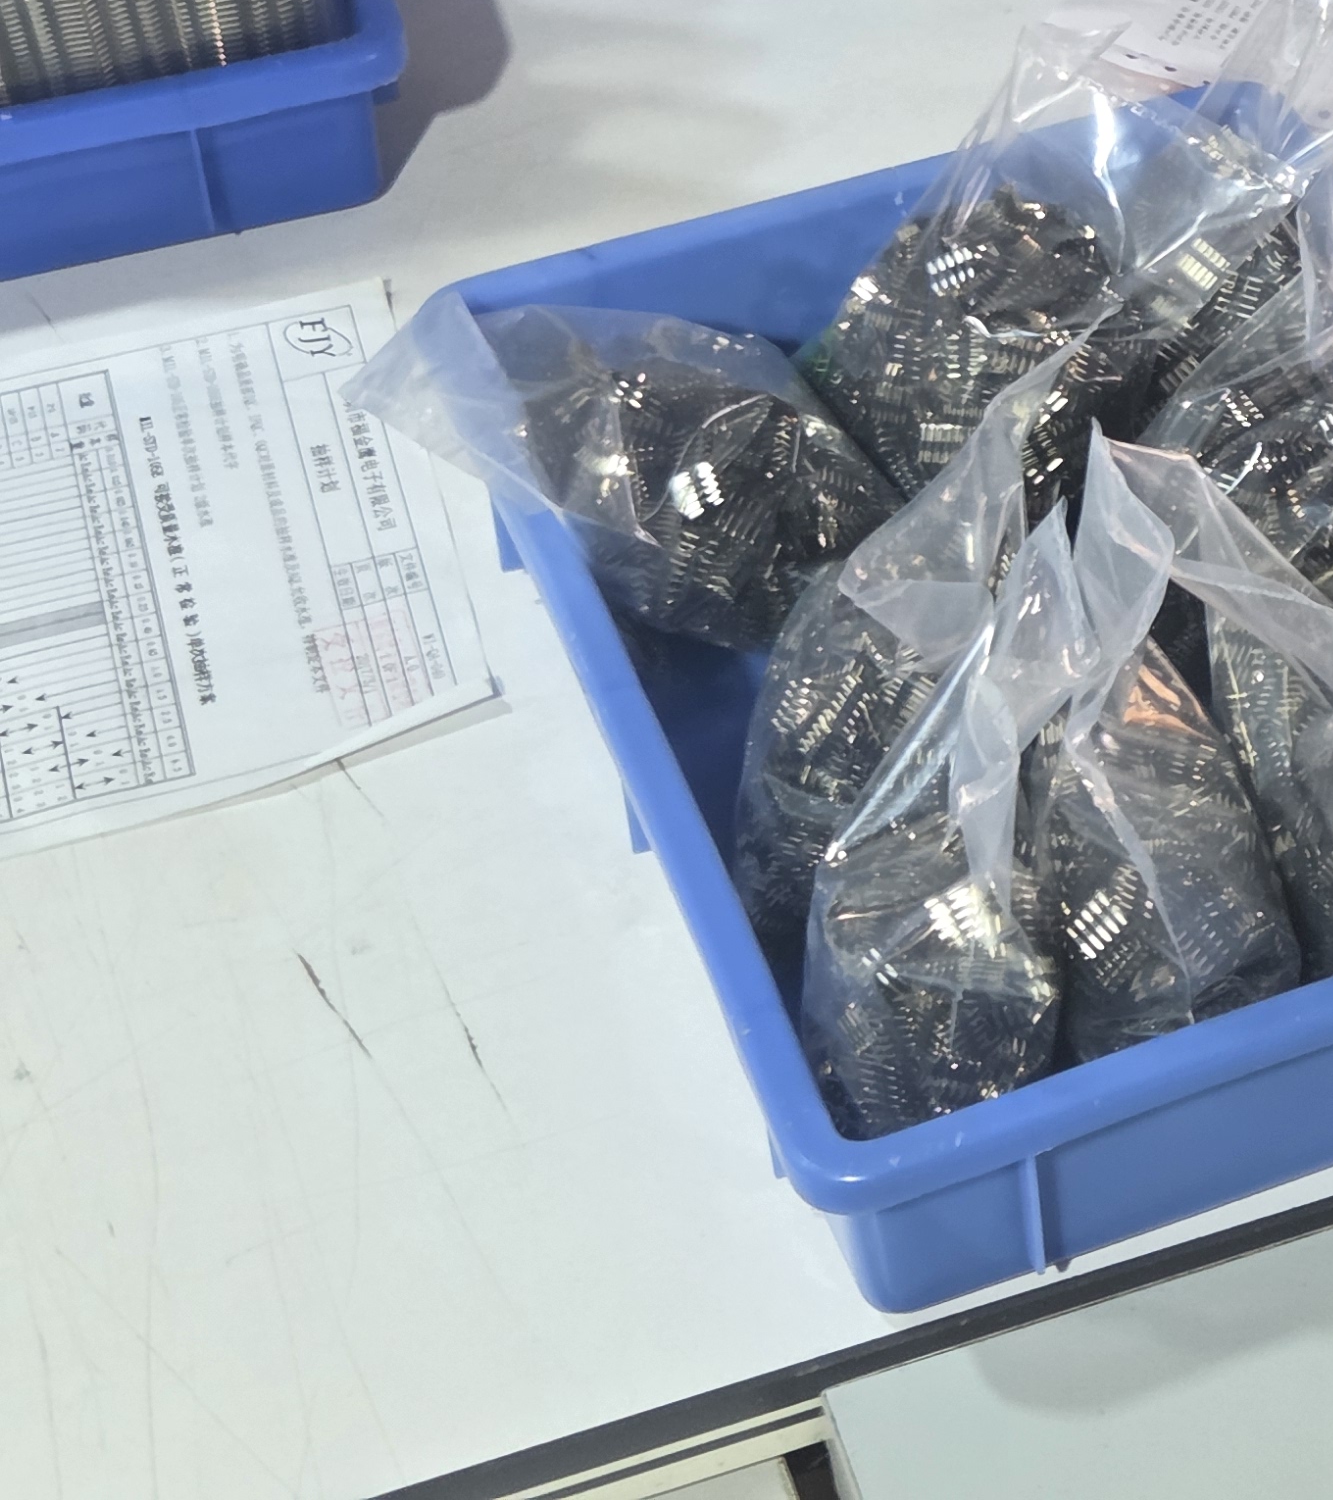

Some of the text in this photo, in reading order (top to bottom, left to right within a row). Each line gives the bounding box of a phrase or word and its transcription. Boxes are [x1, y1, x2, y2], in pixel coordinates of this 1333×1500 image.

[293, 314, 337, 365] FJY
[308, 441, 341, 496] 抽样计划
